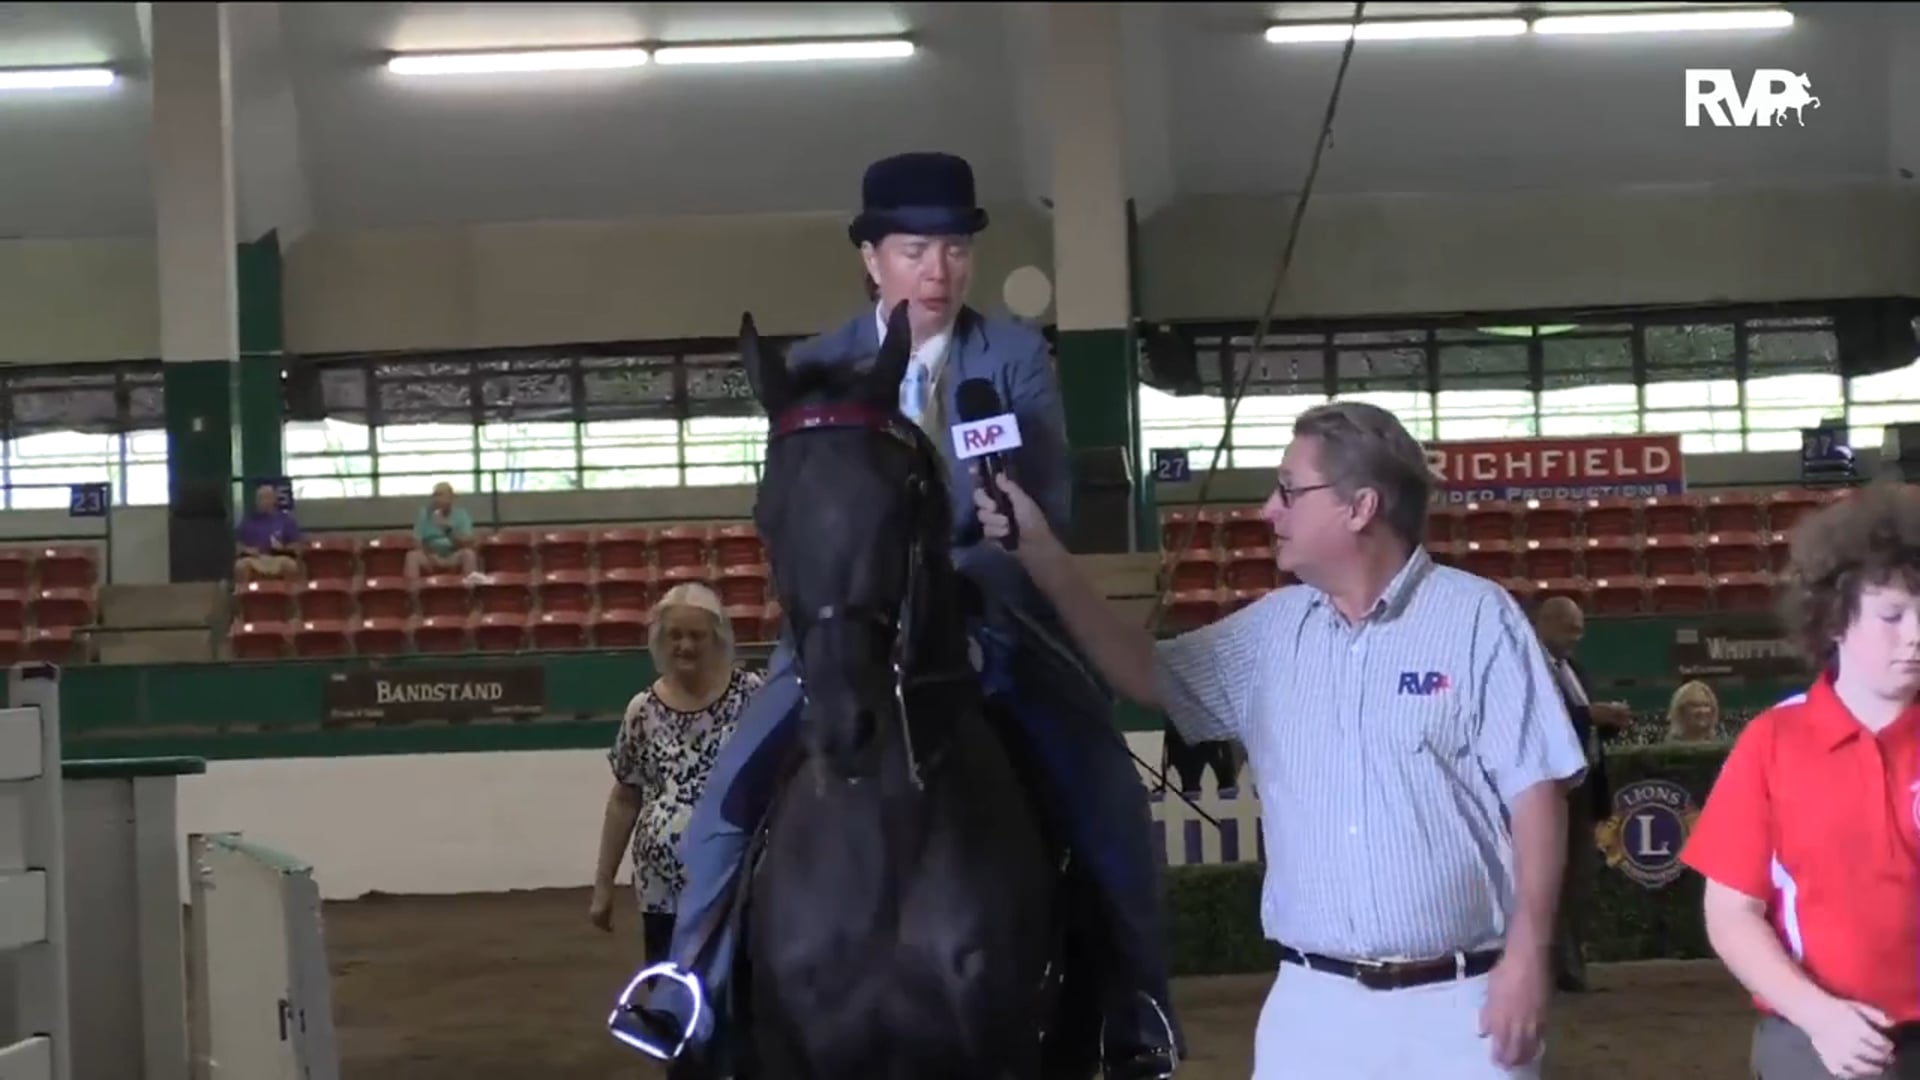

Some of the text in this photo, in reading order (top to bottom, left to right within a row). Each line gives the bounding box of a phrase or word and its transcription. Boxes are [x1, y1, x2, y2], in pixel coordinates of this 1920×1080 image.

[963, 424, 1004, 451] RVP
[1158, 457, 1185, 478] 27
[1425, 447, 1671, 481] RICHFIELD
[73, 491, 101, 512] 23
[1506, 483, 1668, 501] PRODUCTIONS
[376, 681, 503, 703] BANDSTAND
[1398, 671, 1443, 696] RVP
[1623, 786, 1681, 805] LIONS
[1635, 814, 1671, 856] L
